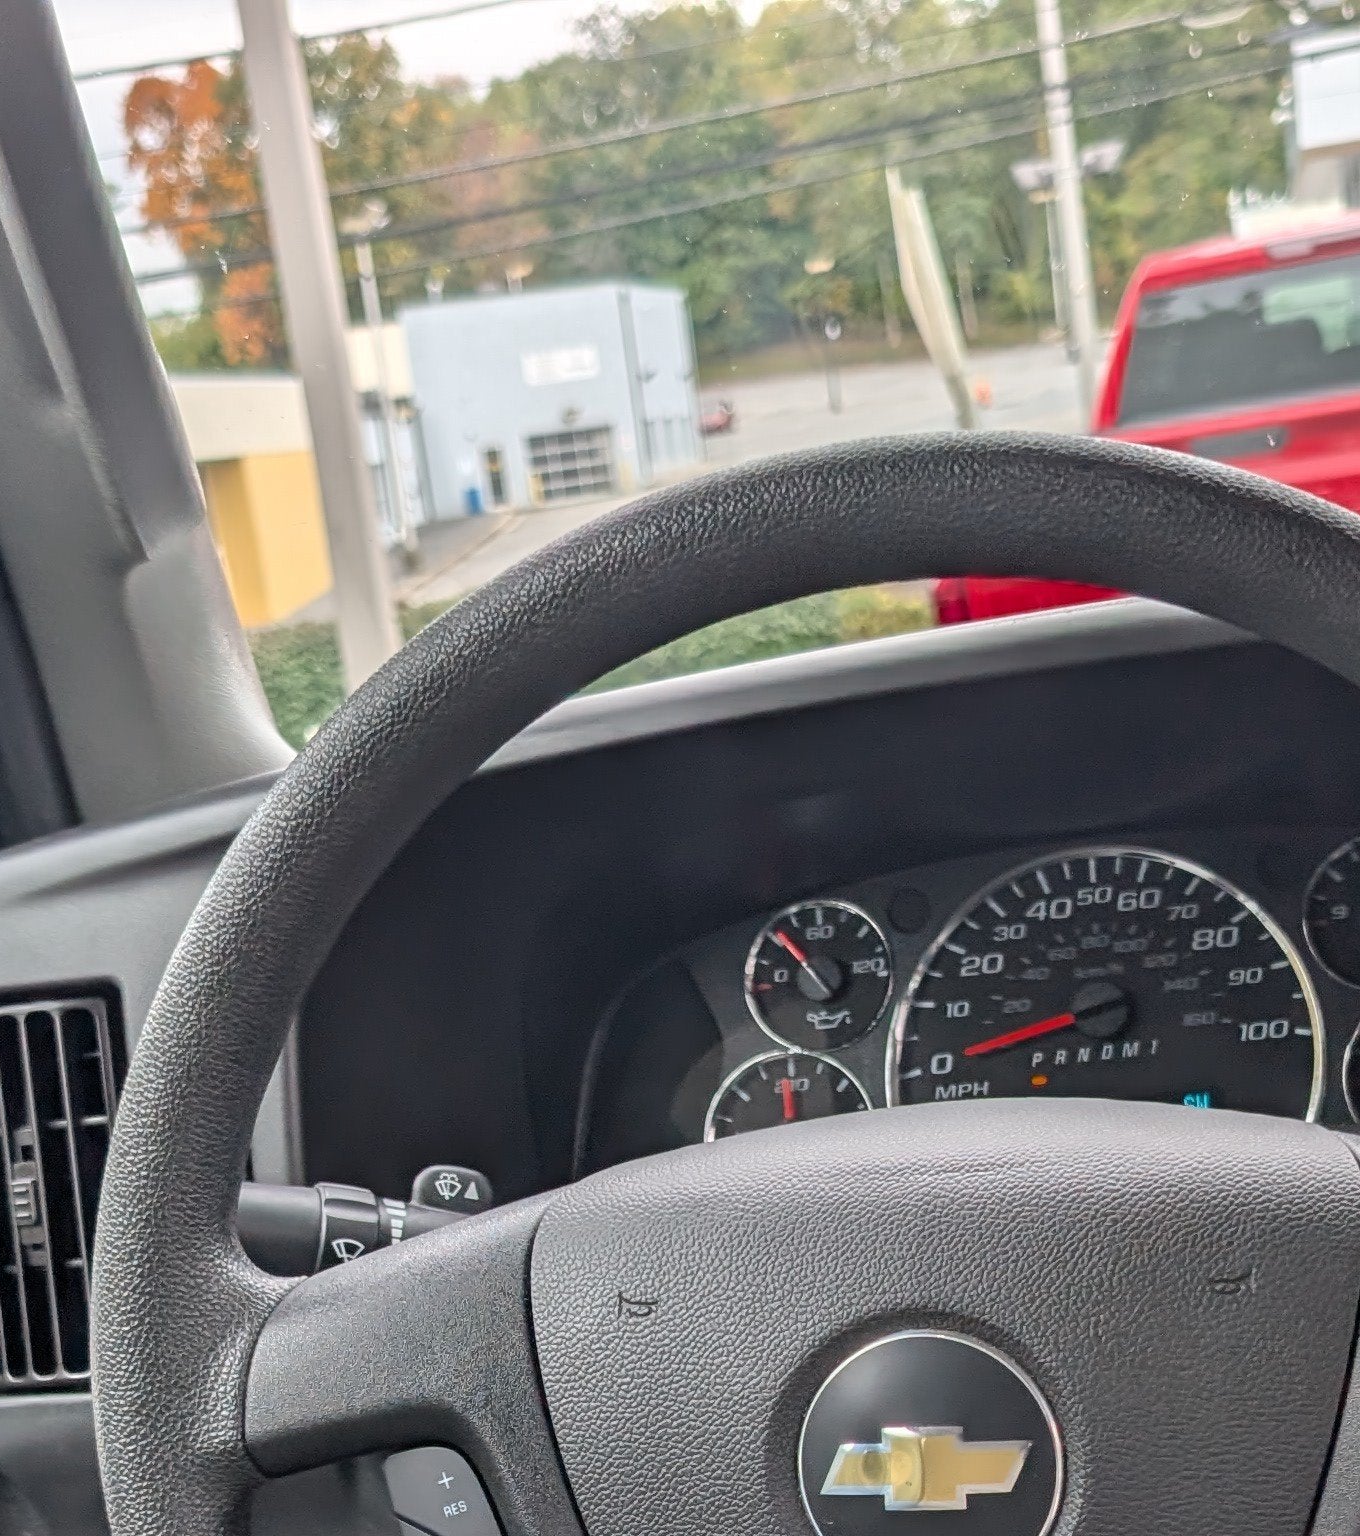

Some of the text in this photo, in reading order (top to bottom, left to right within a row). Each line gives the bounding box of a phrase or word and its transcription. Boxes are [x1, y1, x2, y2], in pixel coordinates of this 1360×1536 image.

[1077, 886, 1113, 906] 50
[1117, 888, 1162, 912] 60
[1026, 897, 1073, 921] 40
[1167, 903, 1200, 921] 70
[805, 925, 835, 941] 60
[993, 924, 1027, 942] 30
[1192, 926, 1239, 950] 80
[773, 968, 789, 983] 0
[960, 953, 1004, 978] 20
[1228, 967, 1263, 987] 90
[945, 1001, 971, 1018] 10
[1239, 1020, 1289, 1042] 100
[1031, 1052, 1044, 1067] P
[1077, 1048, 1092, 1063] N
[1101, 1043, 1115, 1061] D
[1122, 1041, 1140, 1058] M
[930, 1054, 953, 1075] 0
[934, 1081, 989, 1100] MPH
[443, 1500, 468, 1518] RES
